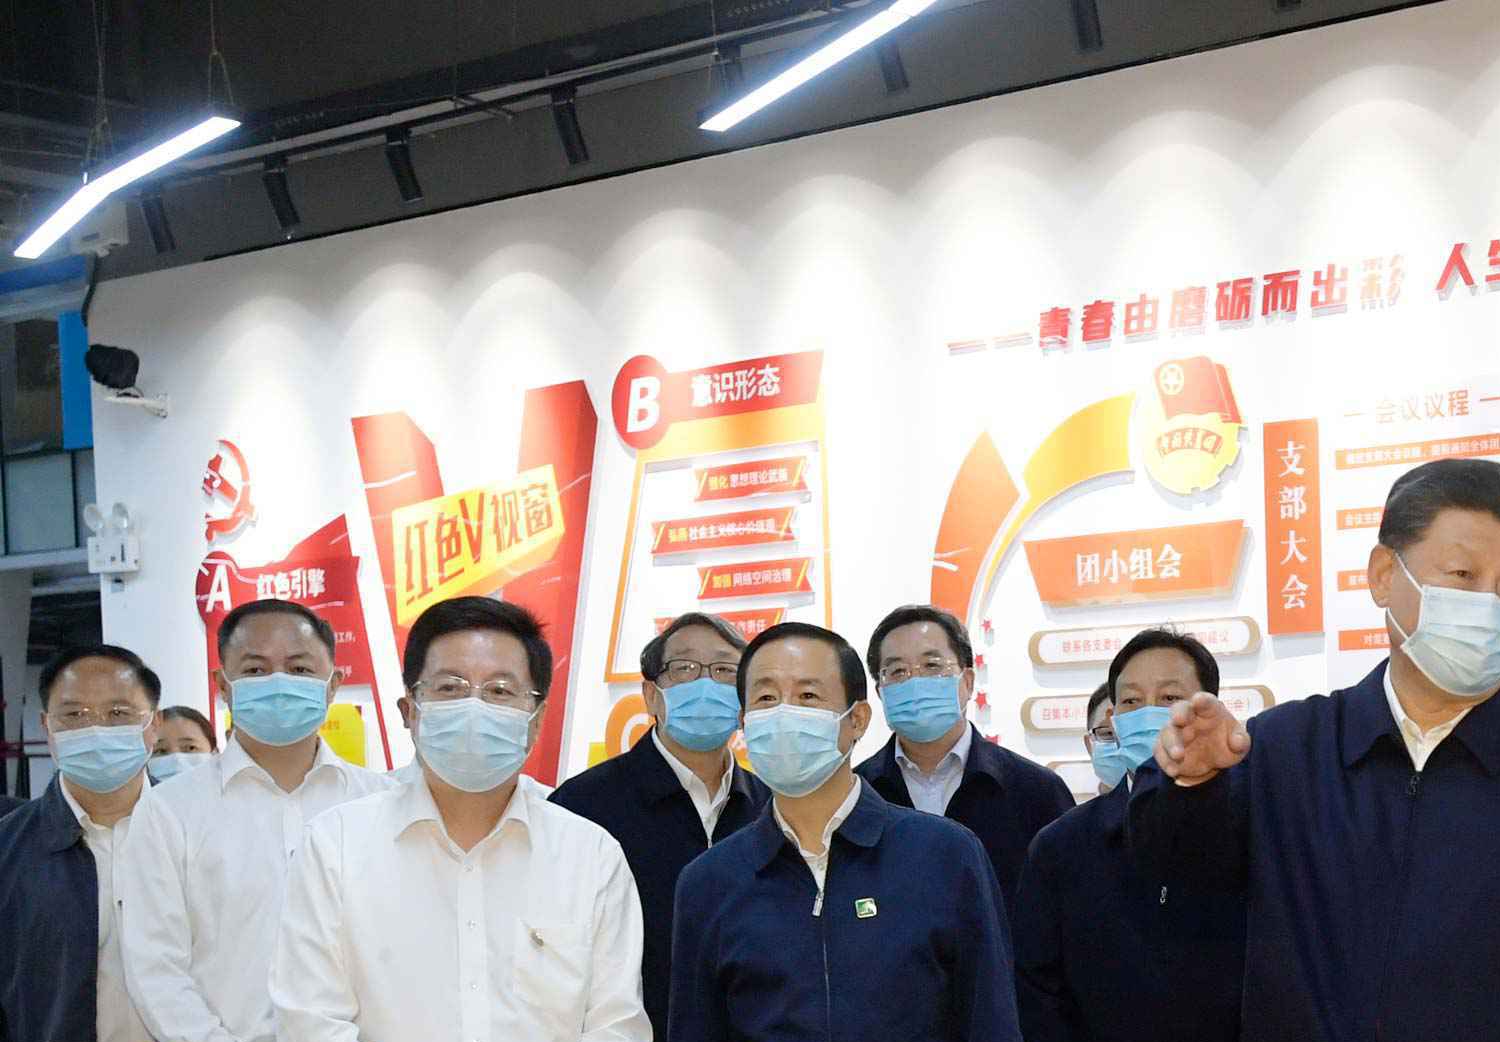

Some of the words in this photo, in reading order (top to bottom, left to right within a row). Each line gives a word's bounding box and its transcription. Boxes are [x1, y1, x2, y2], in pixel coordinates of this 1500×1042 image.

[1039, 253, 1405, 348] 青春由磨砺而出彩
[626, 376, 661, 433] B
[691, 364, 781, 407] 意识形态
[1375, 389, 1469, 423] 会议议程
[405, 483, 553, 606] 红色V视窗
[1276, 439, 1309, 609] 支部大会
[206, 563, 232, 613] A
[256, 568, 326, 600] 红色引擎
[1075, 544, 1184, 588] 团小组会
